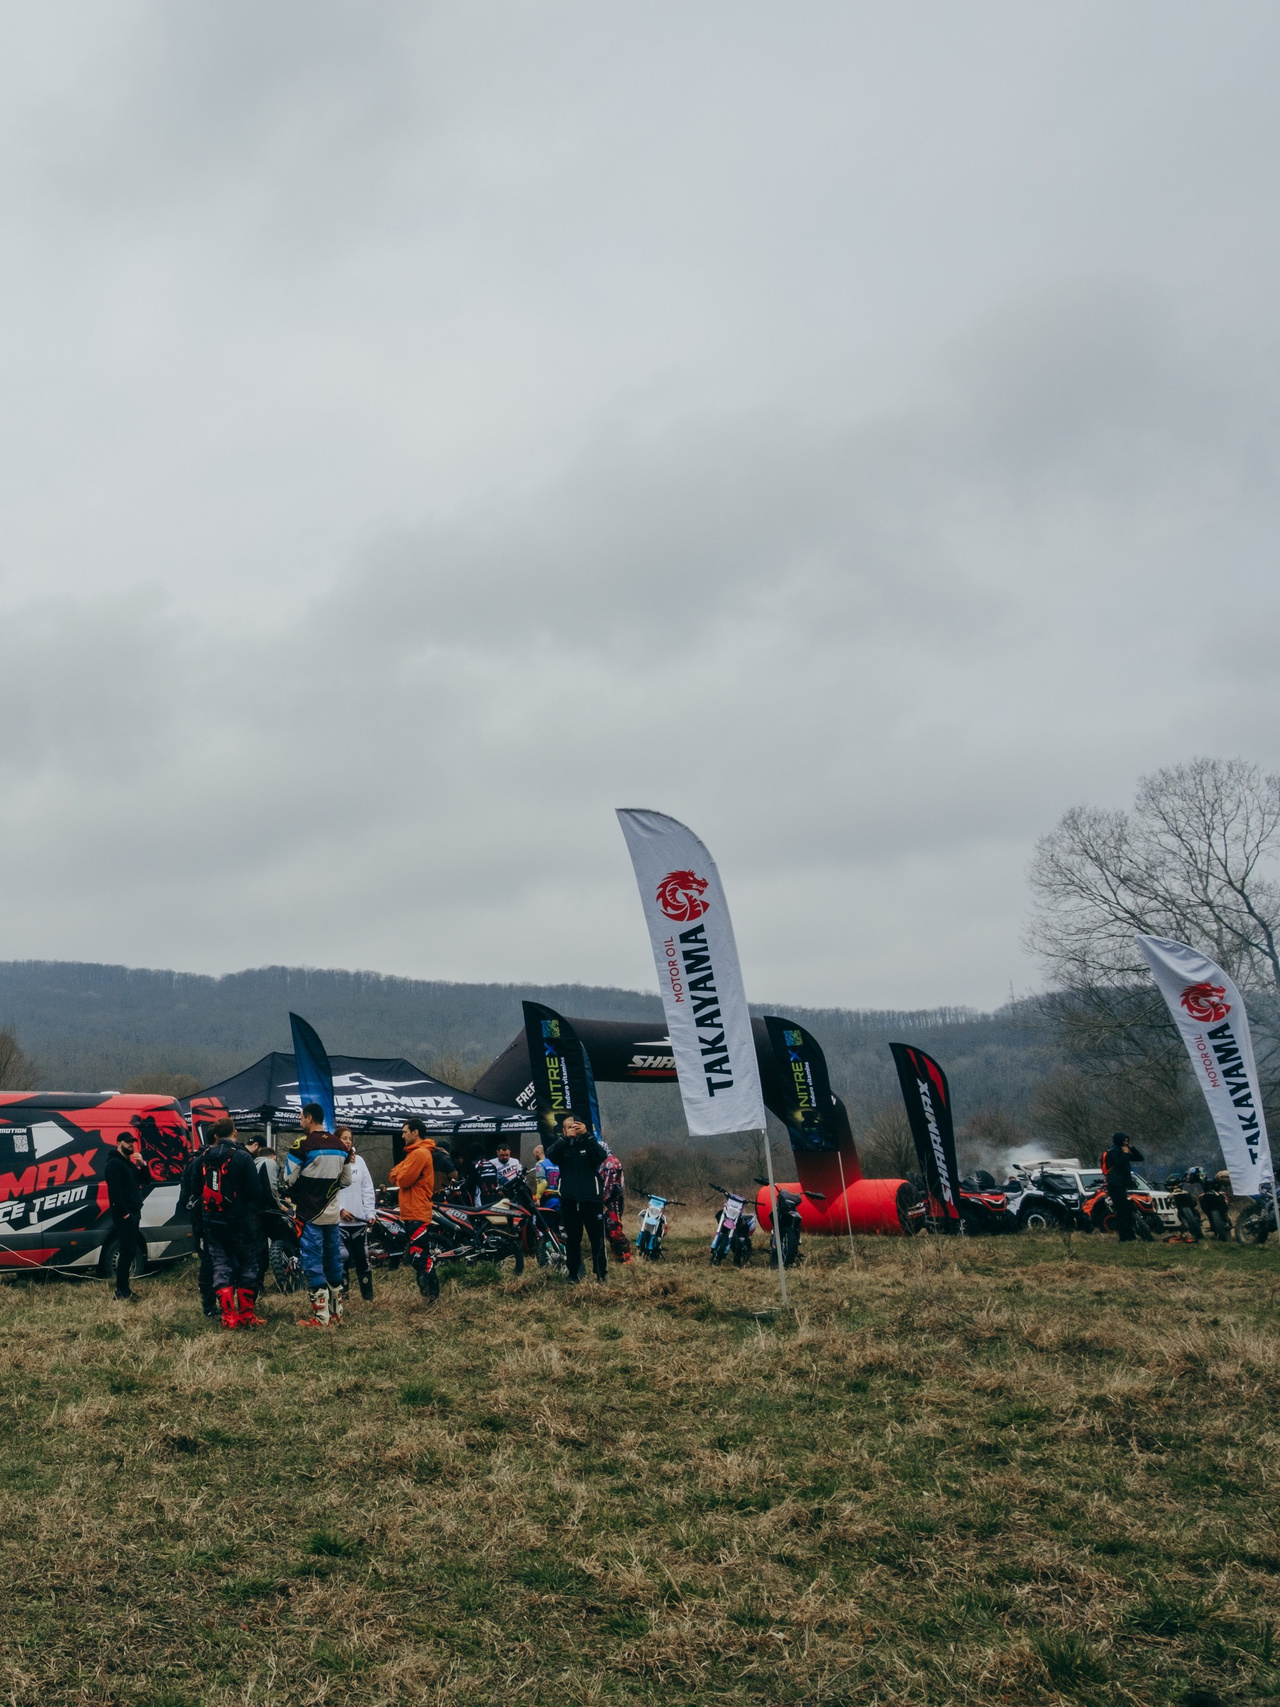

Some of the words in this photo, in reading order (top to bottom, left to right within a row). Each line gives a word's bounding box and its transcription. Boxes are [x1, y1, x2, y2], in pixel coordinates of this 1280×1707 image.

[664, 936, 675, 957] OIL
[668, 960, 684, 1003] MOTOR
[678, 923, 734, 1098] TAKAYAMA
[1194, 1034, 1206, 1051] OIL
[543, 1042, 565, 1110] NITREX
[560, 1057, 568, 1085] vitamins
[788, 1049, 810, 1107] NITREX
[804, 1061, 813, 1086] vitamins
[1200, 1052, 1220, 1087] MOTOR
[809, 1087, 817, 1107] Enduro
[1207, 1022, 1260, 1165] TAKAYAMA
[916, 1078, 954, 1206] SHARMAX
[33, 1185, 89, 1216] TEAM
